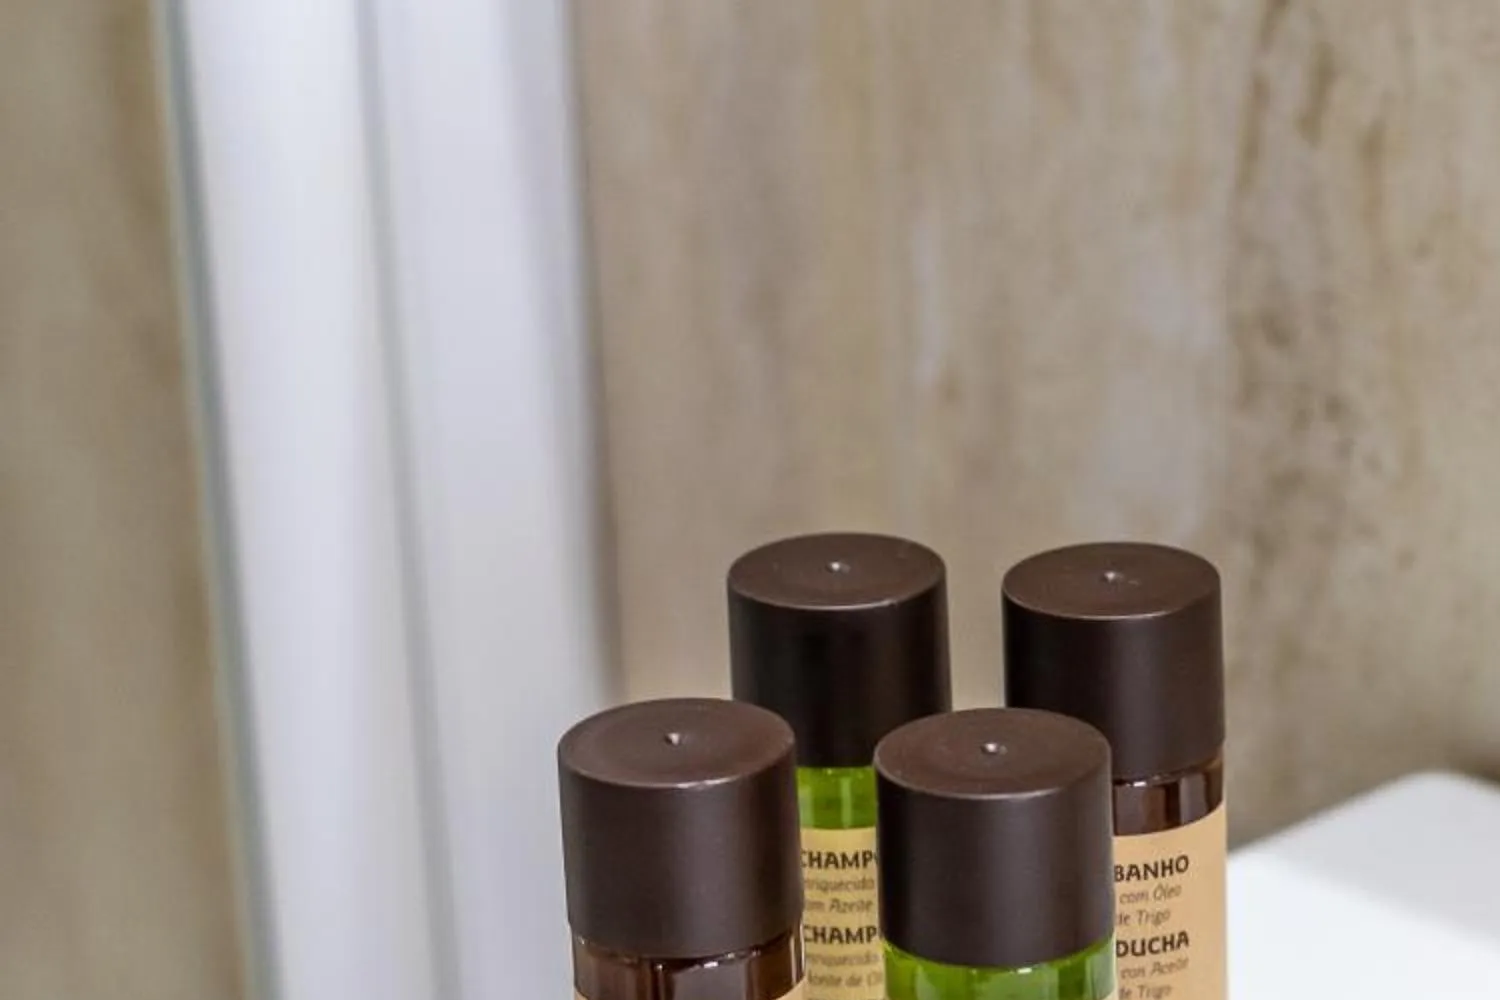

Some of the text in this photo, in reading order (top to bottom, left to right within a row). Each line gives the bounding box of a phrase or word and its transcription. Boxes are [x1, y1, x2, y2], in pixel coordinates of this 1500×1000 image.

[800, 849, 879, 870] CHAMP
[1114, 854, 1189, 882] BANHO
[803, 925, 879, 945] CHAMP
[1115, 930, 1189, 958] DUCHA
